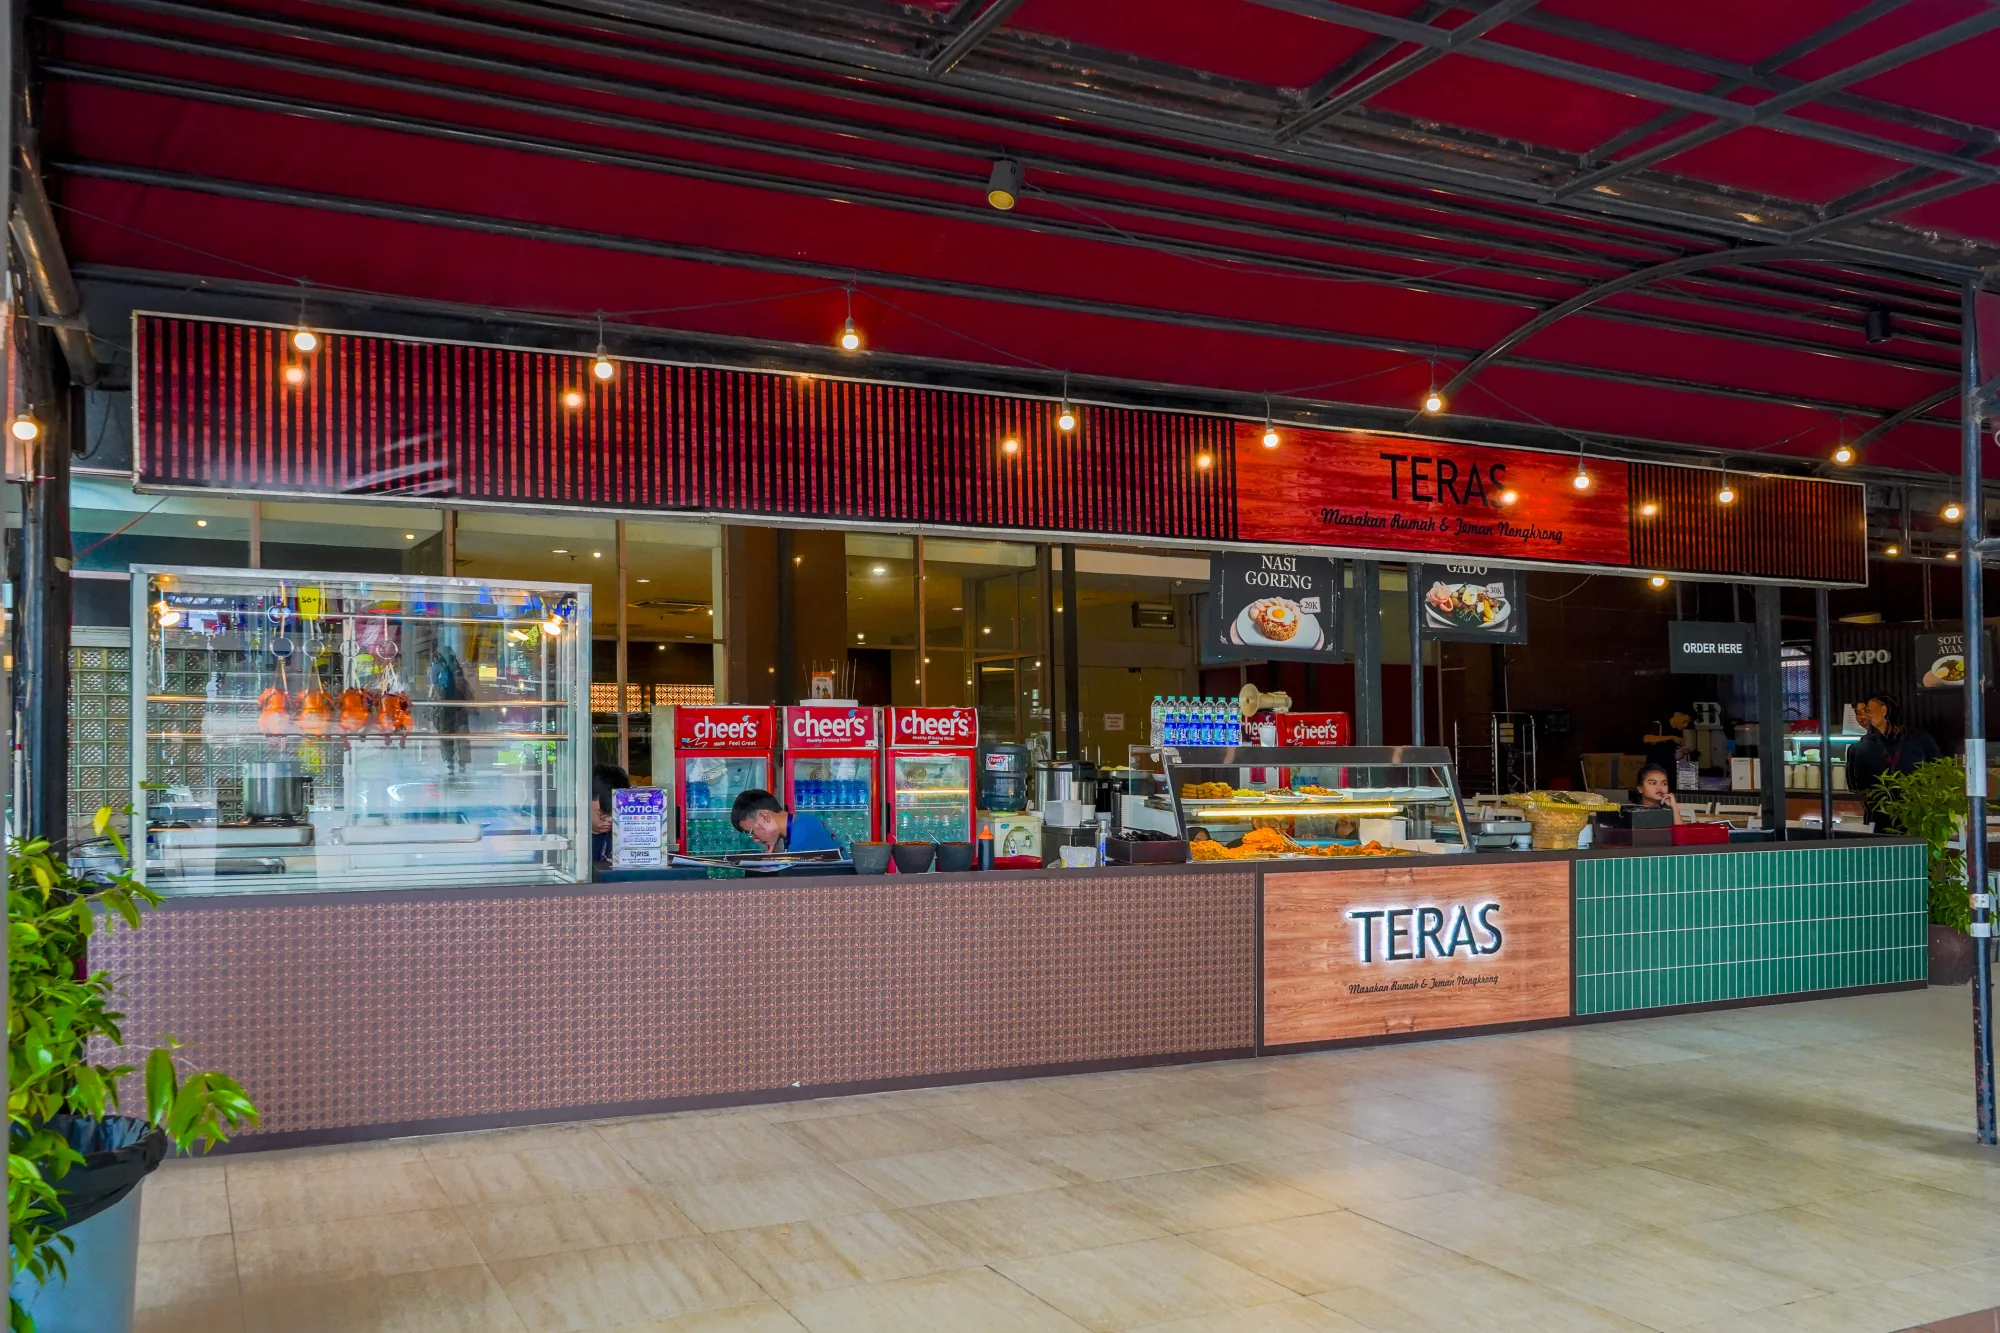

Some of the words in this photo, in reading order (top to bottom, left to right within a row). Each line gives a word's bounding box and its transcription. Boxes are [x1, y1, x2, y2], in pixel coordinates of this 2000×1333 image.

[1380, 453, 1508, 508] TERAS
[1321, 507, 1386, 528] Masakan
[1390, 513, 1435, 531] Rumah
[1439, 517, 1450, 532] &
[1497, 521, 1563, 543] Nongkrong
[1261, 555, 1297, 572] NASI
[1245, 571, 1312, 590] GORENG
[1490, 586, 1502, 594] 30K
[1304, 602, 1318, 610] 20K
[1683, 642, 1716, 654] ORDER
[1718, 643, 1743, 654] HERE
[620, 805, 659, 813] NOTICE
[1349, 903, 1502, 963] TERAS
[1348, 984, 1388, 994] Masakan
[1391, 980, 1418, 991] Rumah
[1421, 979, 1428, 988] &
[1456, 975, 1498, 986] Nongkrong
